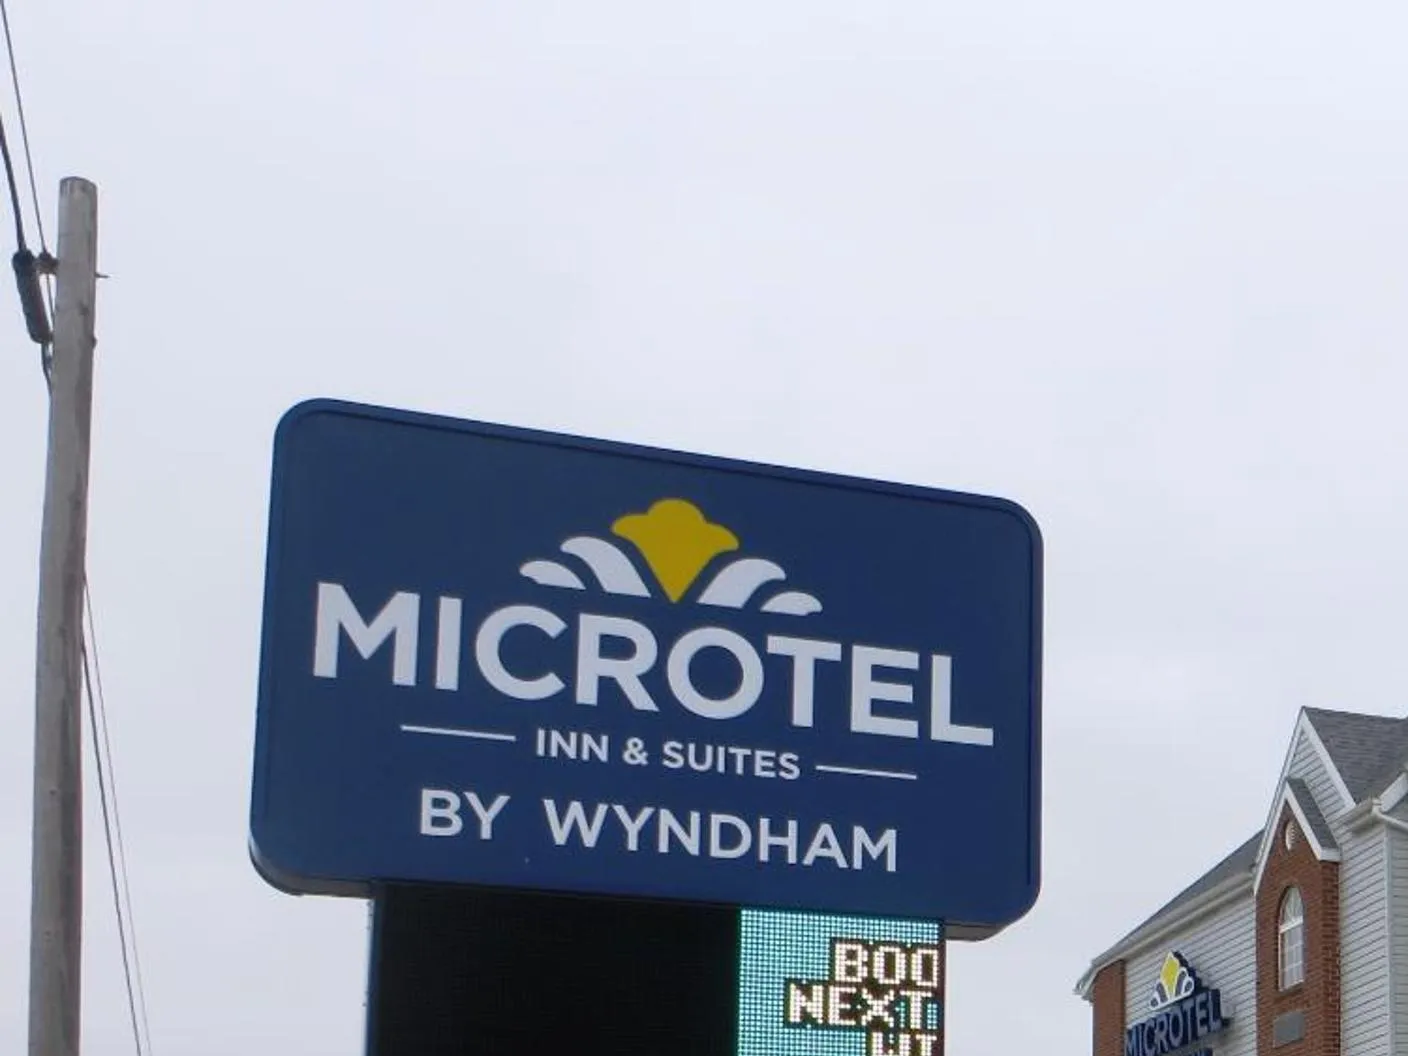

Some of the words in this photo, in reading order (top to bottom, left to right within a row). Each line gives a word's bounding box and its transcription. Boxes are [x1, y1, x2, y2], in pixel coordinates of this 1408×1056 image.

[312, 581, 995, 747] MICROTEL
[535, 727, 609, 765] INN
[622, 738, 650, 767] &
[662, 739, 801, 781] SUITES
[419, 787, 510, 841] BY
[542, 798, 899, 874] WYNDHAM
[788, 983, 933, 1031] NEXT
